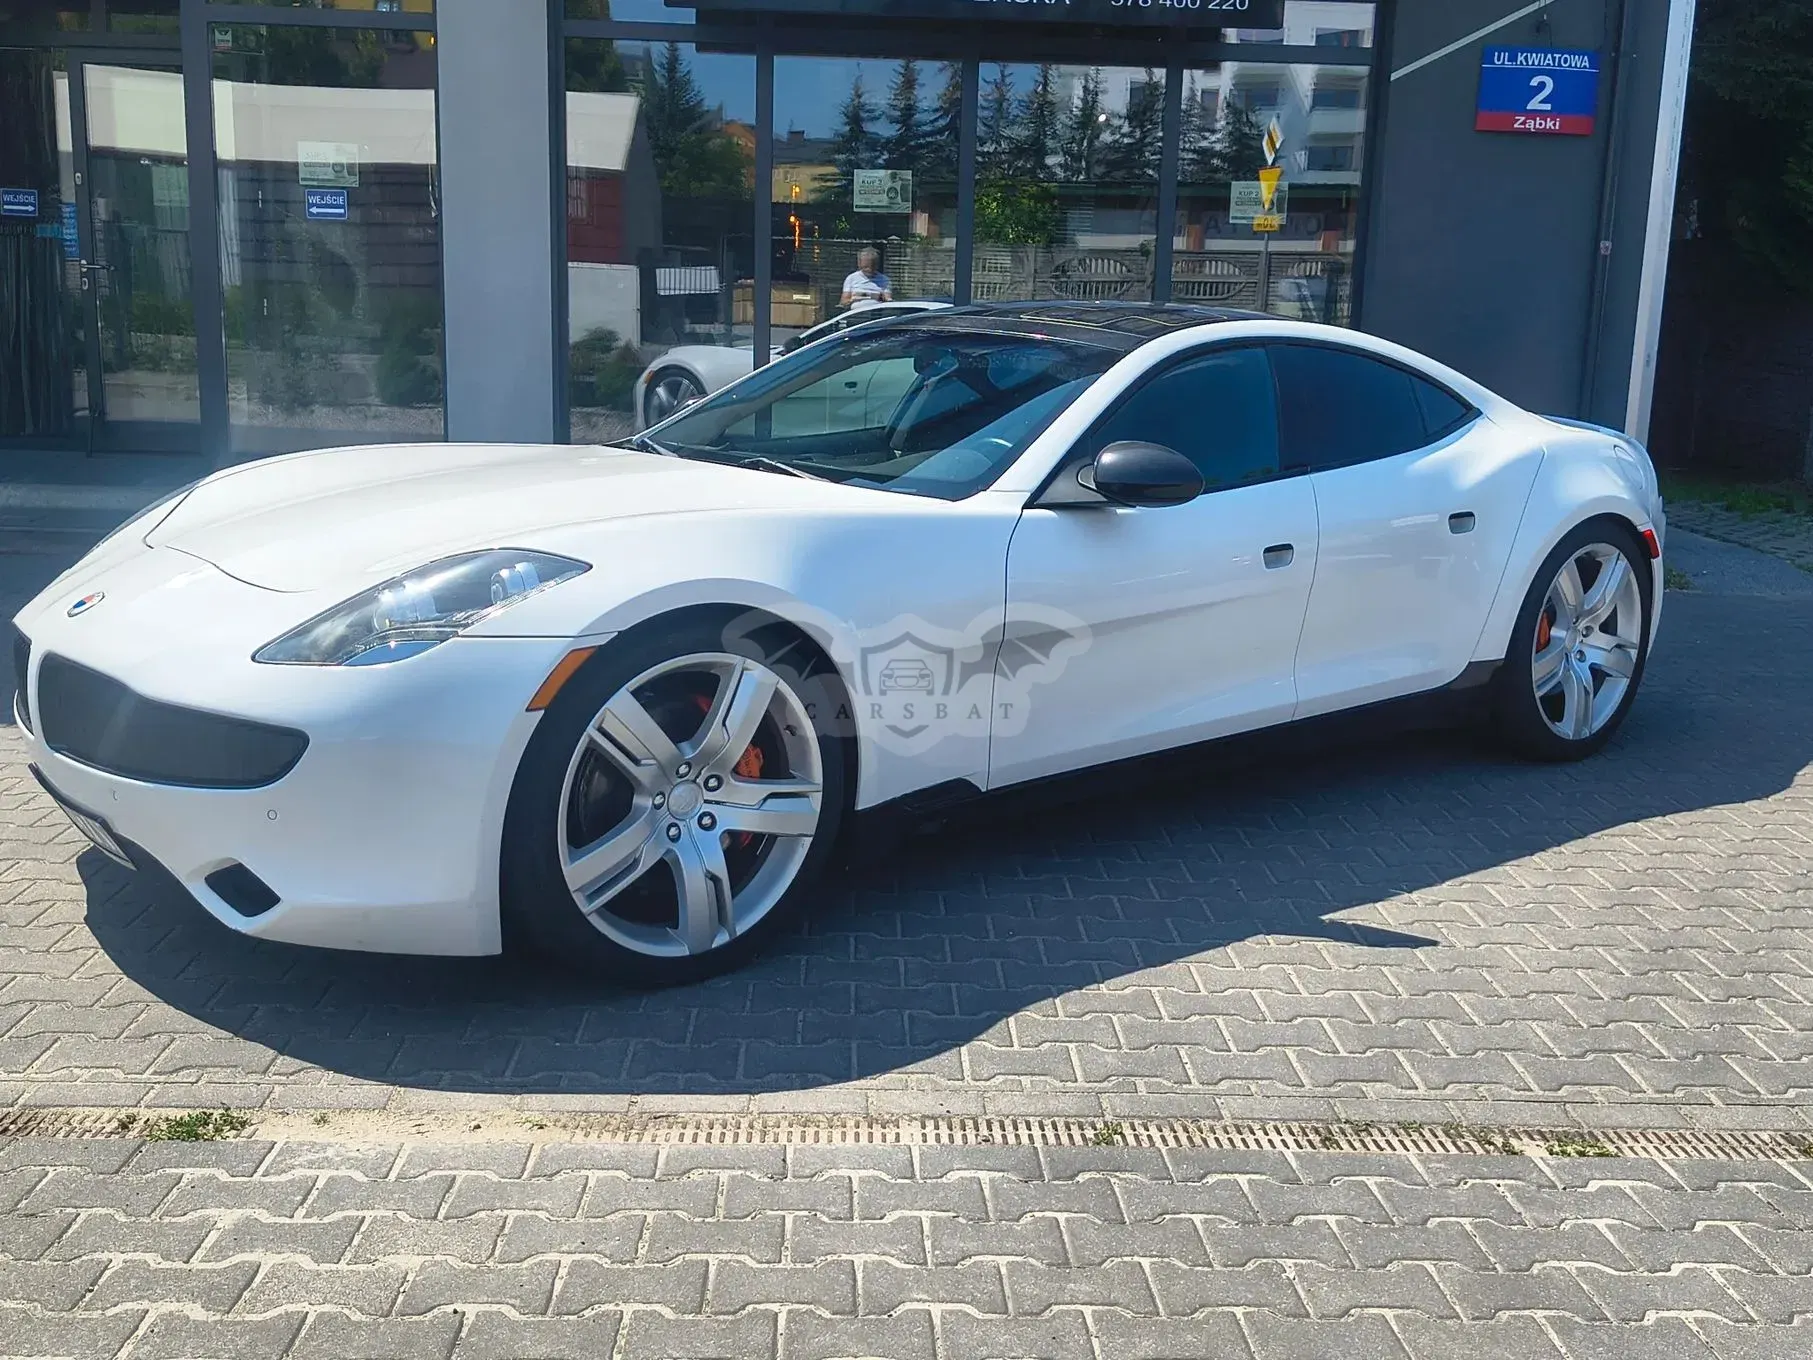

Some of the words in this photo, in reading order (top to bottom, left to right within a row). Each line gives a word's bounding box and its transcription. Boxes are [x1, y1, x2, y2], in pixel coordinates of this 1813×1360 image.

[1493, 51, 1590, 68] UL.KWIATOWA
[1526, 75, 1554, 110] 2
[1513, 116, 1561, 131] Ząbki
[3, 194, 36, 203] WEJŚCIE
[308, 194, 345, 205] WEJŚCIE
